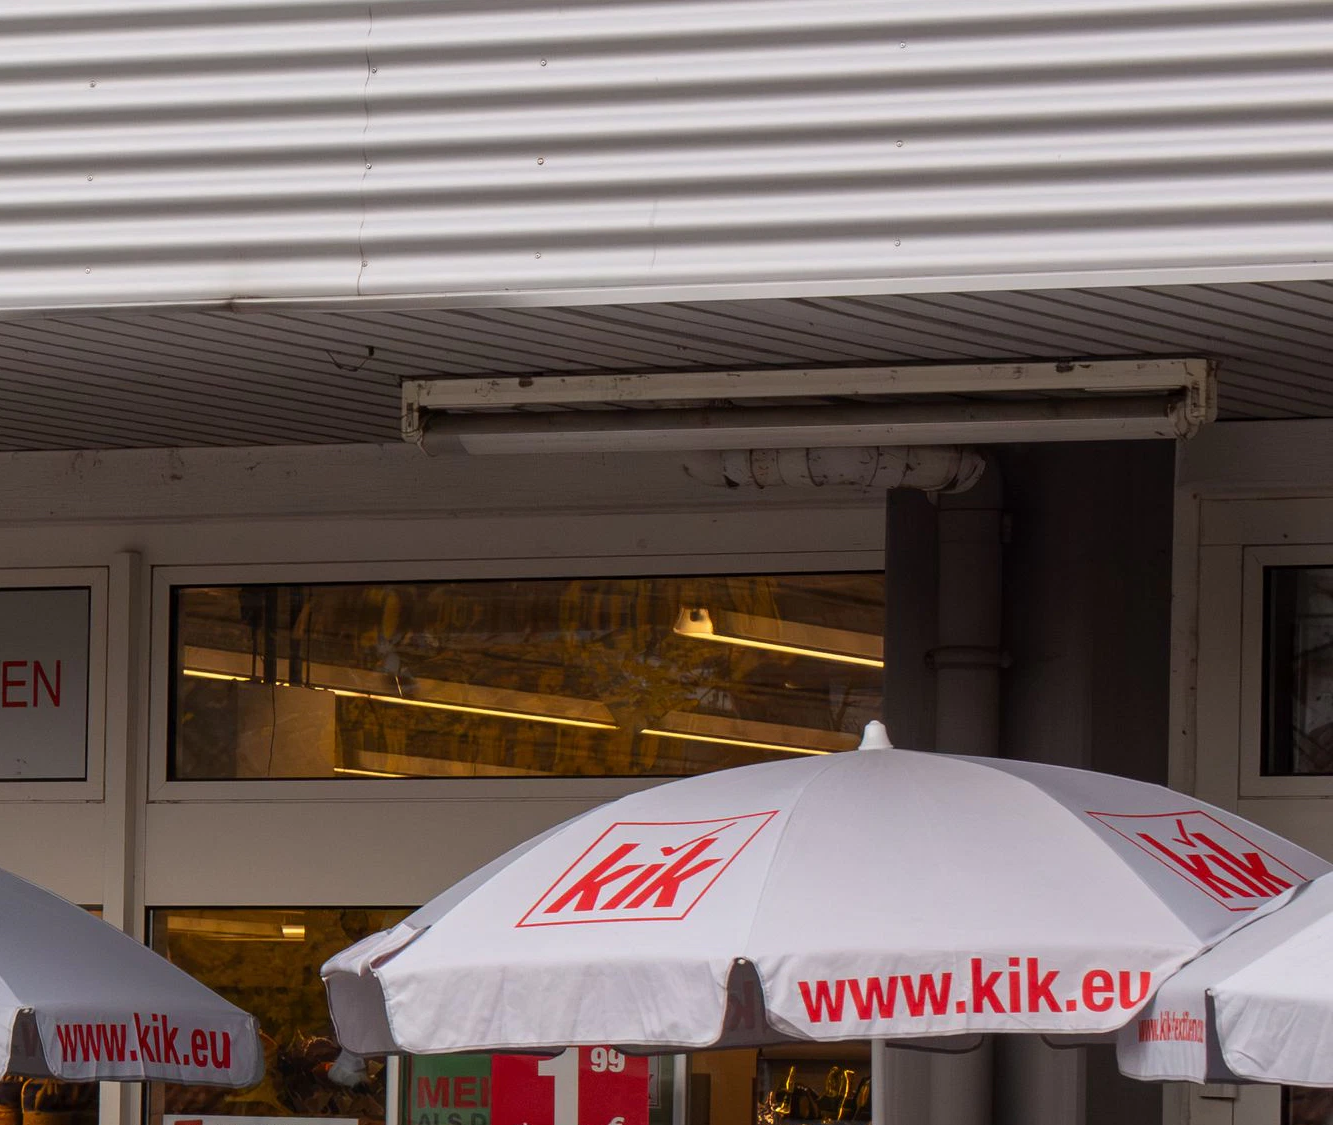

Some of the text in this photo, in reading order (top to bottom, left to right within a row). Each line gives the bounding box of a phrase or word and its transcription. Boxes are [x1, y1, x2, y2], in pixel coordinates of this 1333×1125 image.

[545, 822, 730, 913] kik
[1136, 819, 1294, 898] kik
[798, 956, 1151, 1025] www.kik.eu
[57, 1014, 230, 1068] www.kik.eu
